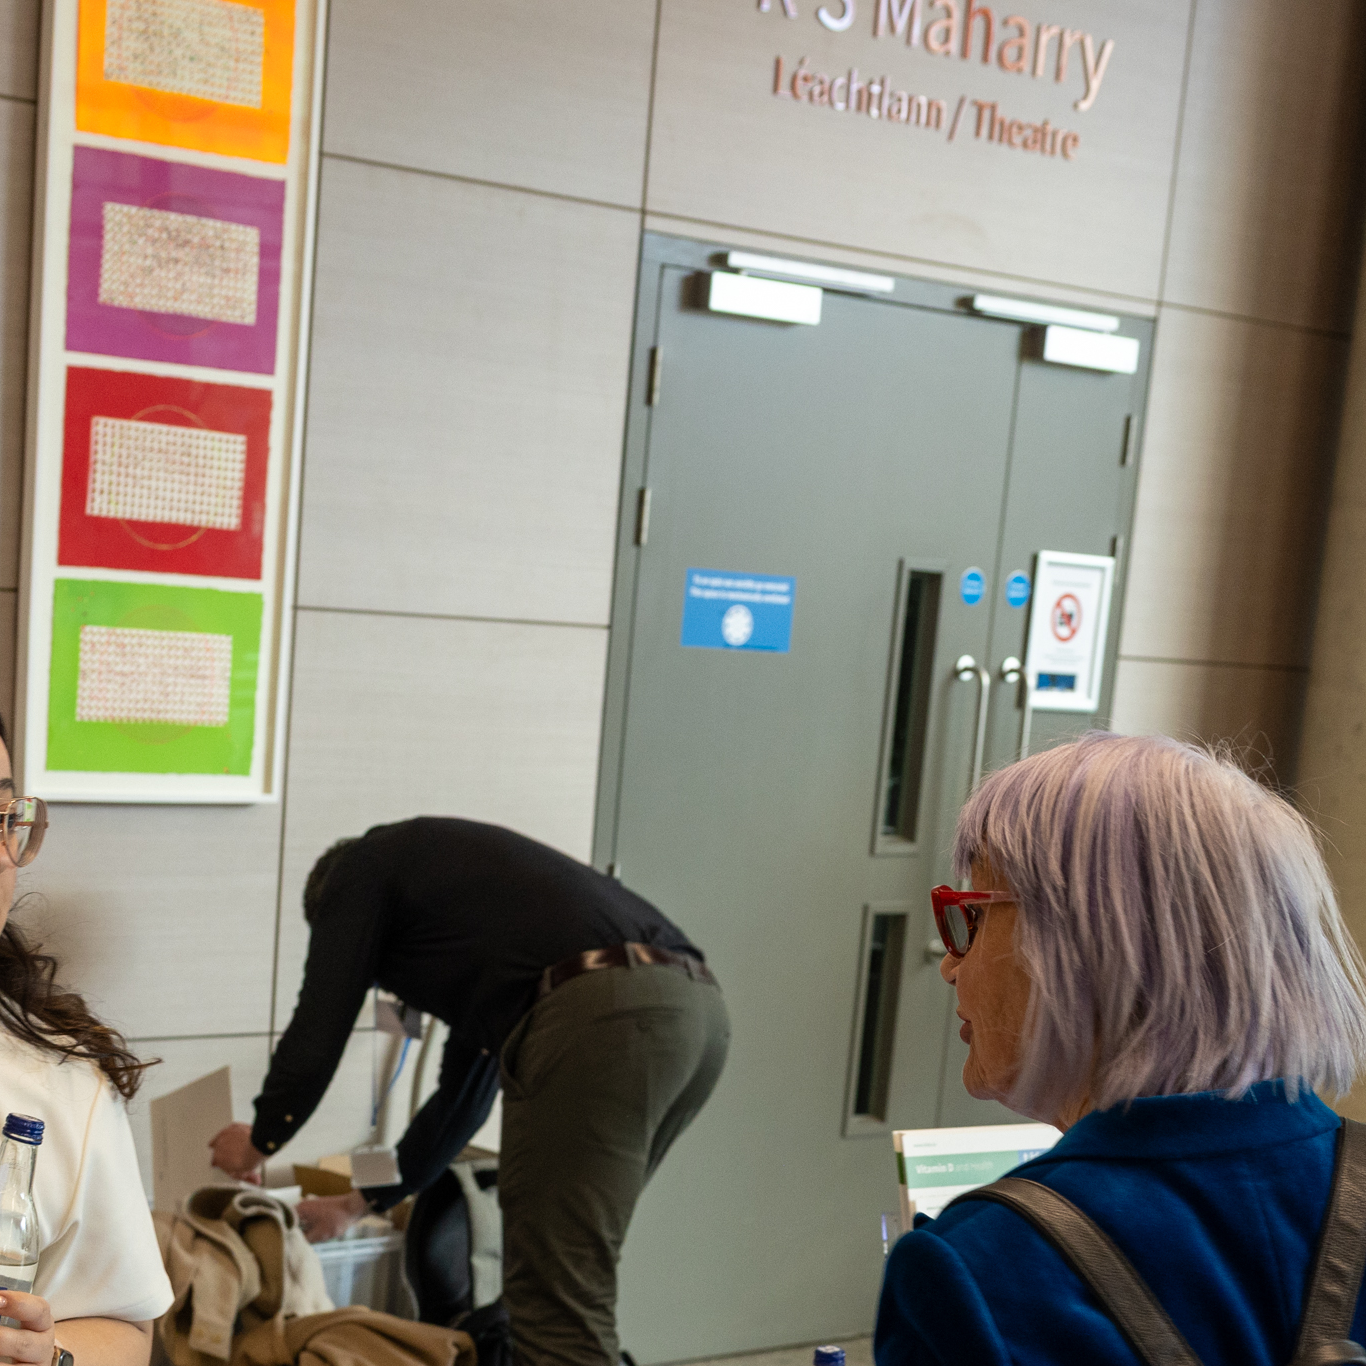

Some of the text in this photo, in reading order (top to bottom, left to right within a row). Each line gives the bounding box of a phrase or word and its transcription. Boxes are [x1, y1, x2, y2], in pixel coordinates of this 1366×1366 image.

[872, 0, 1115, 112] Maharry
[947, 95, 968, 143] /
[971, 98, 1080, 161] Theatre
[915, 1164, 947, 1174] Vitamin
[948, 1163, 954, 1172] D
